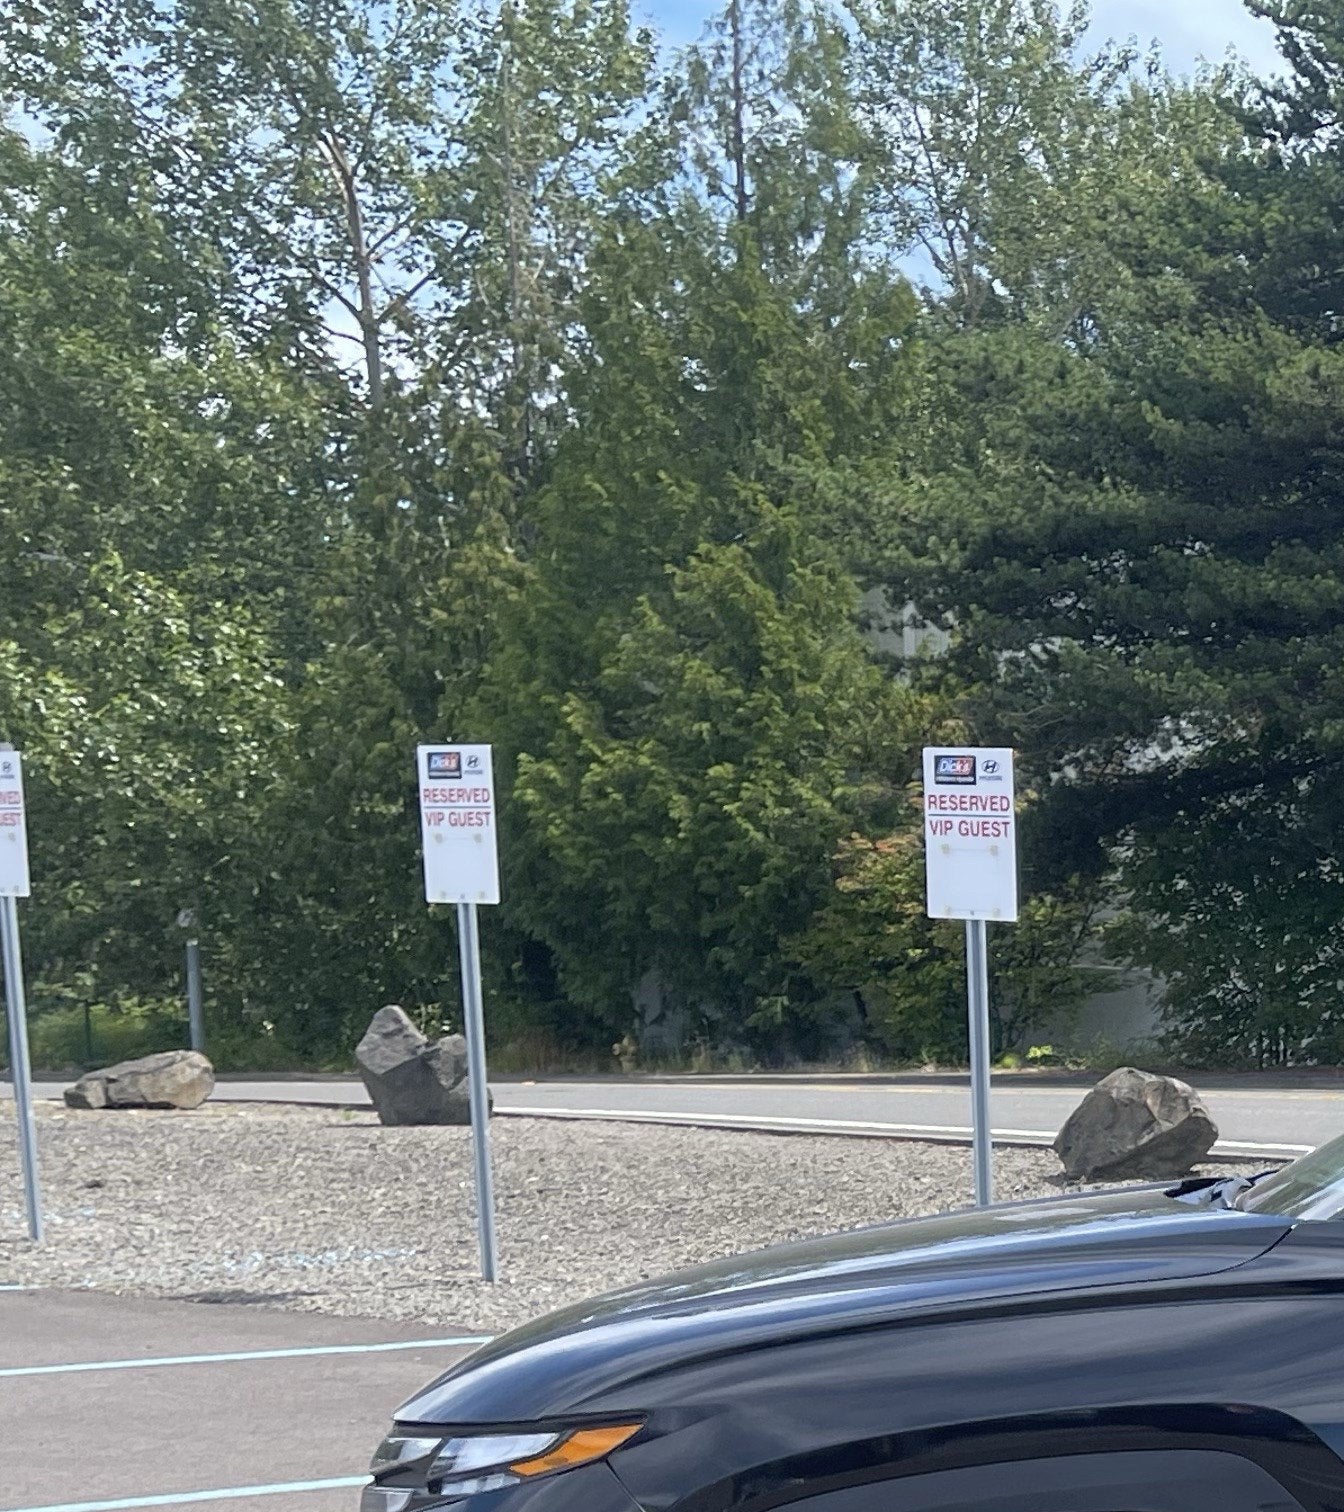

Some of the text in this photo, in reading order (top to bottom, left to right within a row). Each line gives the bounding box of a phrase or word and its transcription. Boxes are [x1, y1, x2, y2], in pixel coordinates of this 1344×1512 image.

[423, 788, 490, 803] RESERVED
[928, 794, 1010, 812] RESERVED
[425, 811, 490, 827] VIP GUEST
[929, 820, 1010, 838] VIP GUEST
